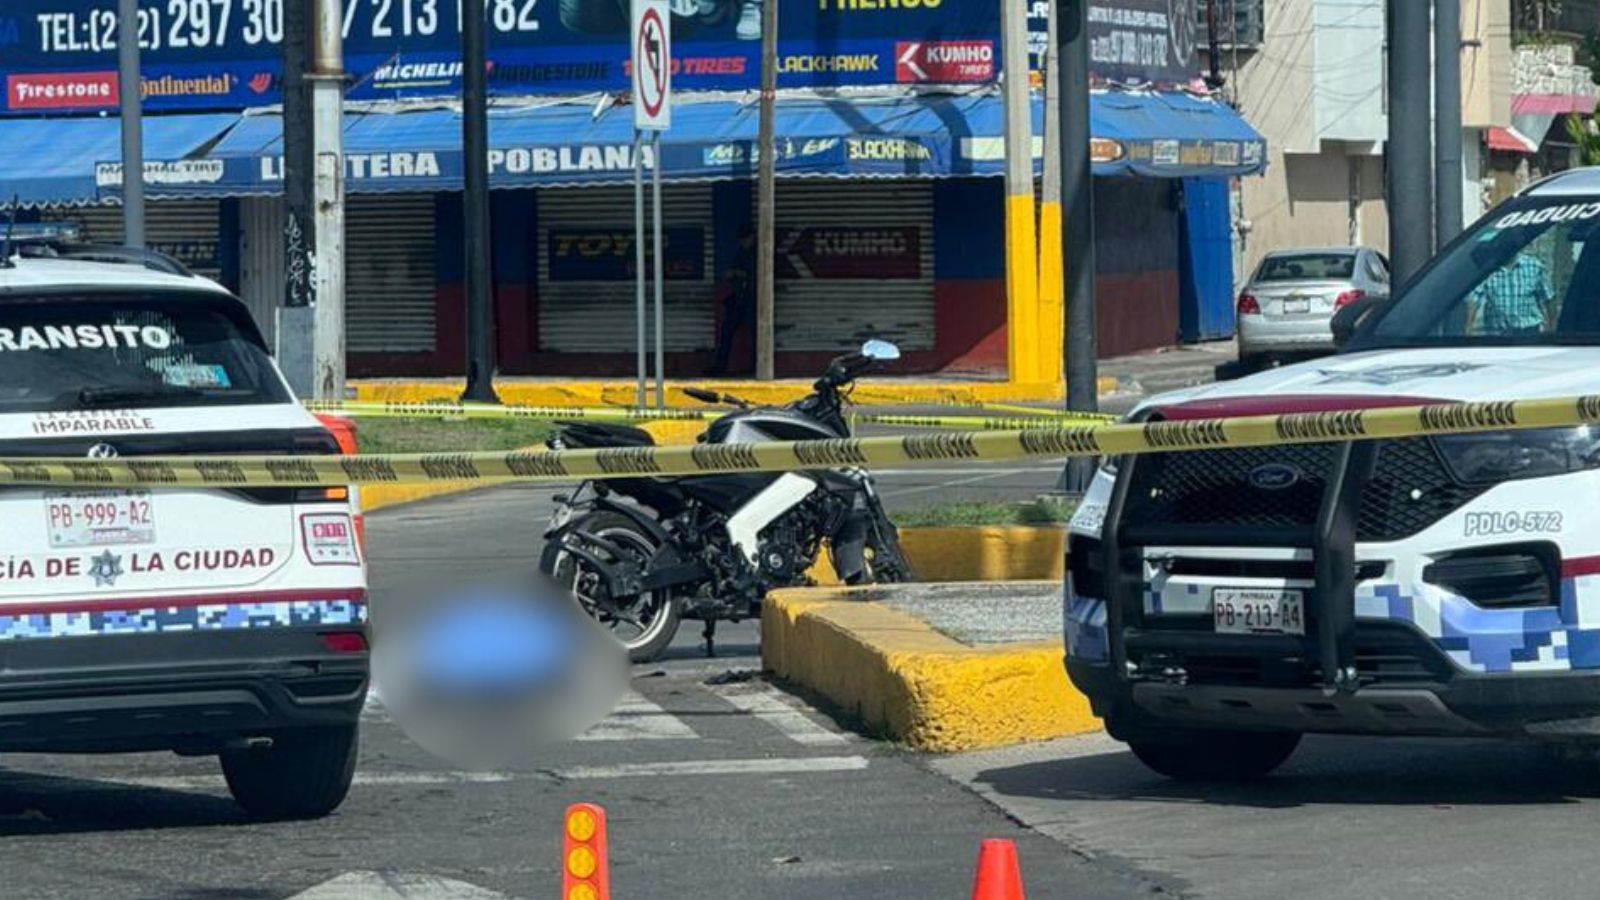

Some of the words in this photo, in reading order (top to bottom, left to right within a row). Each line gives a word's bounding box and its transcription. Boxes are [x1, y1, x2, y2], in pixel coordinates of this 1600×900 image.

[37, 8, 161, 52] TEL:(22)
[167, 0, 232, 47] 297
[371, 0, 438, 37] 213
[683, 57, 747, 75] TIRES
[776, 55, 879, 73] LACKHAWK
[926, 45, 992, 63] KUMHO
[15, 82, 111, 101] Firestone
[139, 73, 230, 99] ontinental
[260, 151, 441, 182] LTERA
[813, 231, 907, 256] KUMHO
[32, 417, 155, 434] IMPARABLE
[49, 500, 152, 528] PB-999-A2
[45, 558, 82, 578] DE
[131, 552, 165, 573] LA
[173, 547, 275, 571] CIUDAD
[1215, 602, 1300, 626] PB-213-A4
